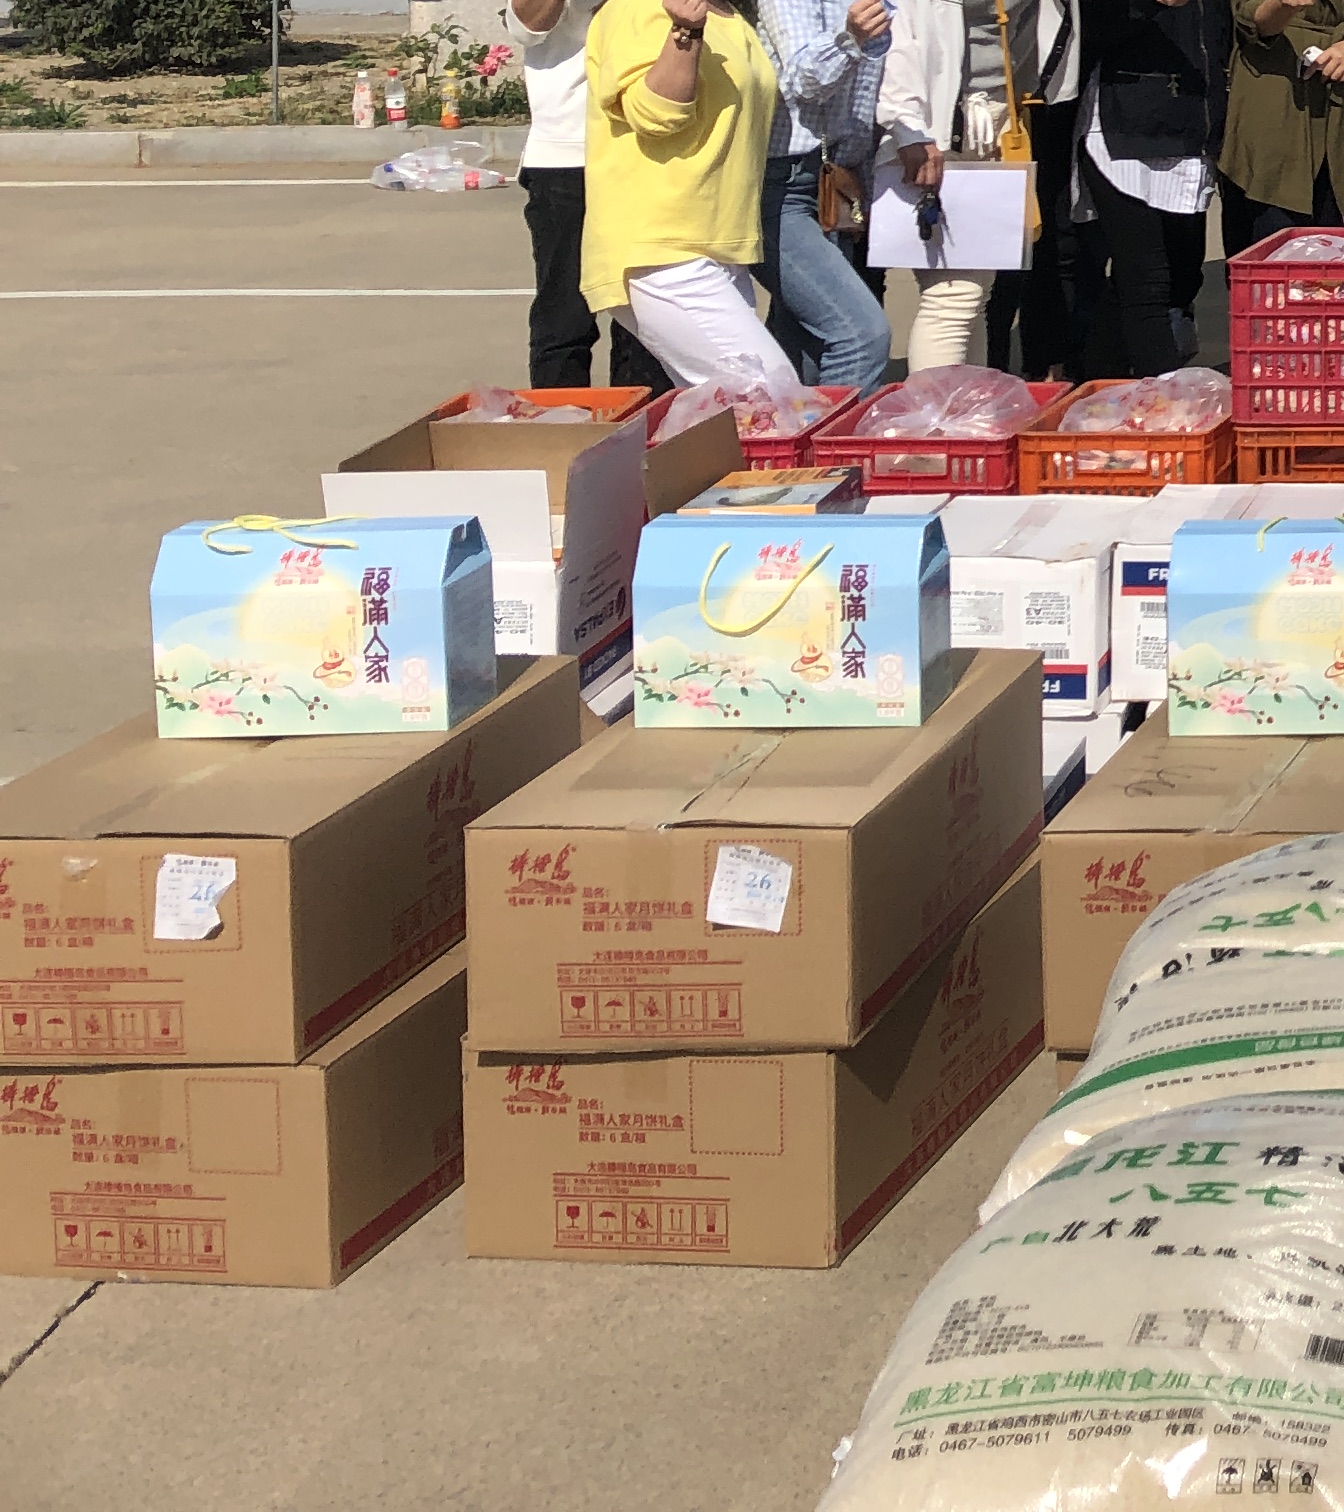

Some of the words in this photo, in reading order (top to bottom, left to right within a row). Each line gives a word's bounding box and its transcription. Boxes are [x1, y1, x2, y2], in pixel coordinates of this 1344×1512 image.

[745, 871, 772, 890] 26
[1109, 1181, 1308, 1205] 八五七
[1066, 1423, 1133, 1443] 5079499
